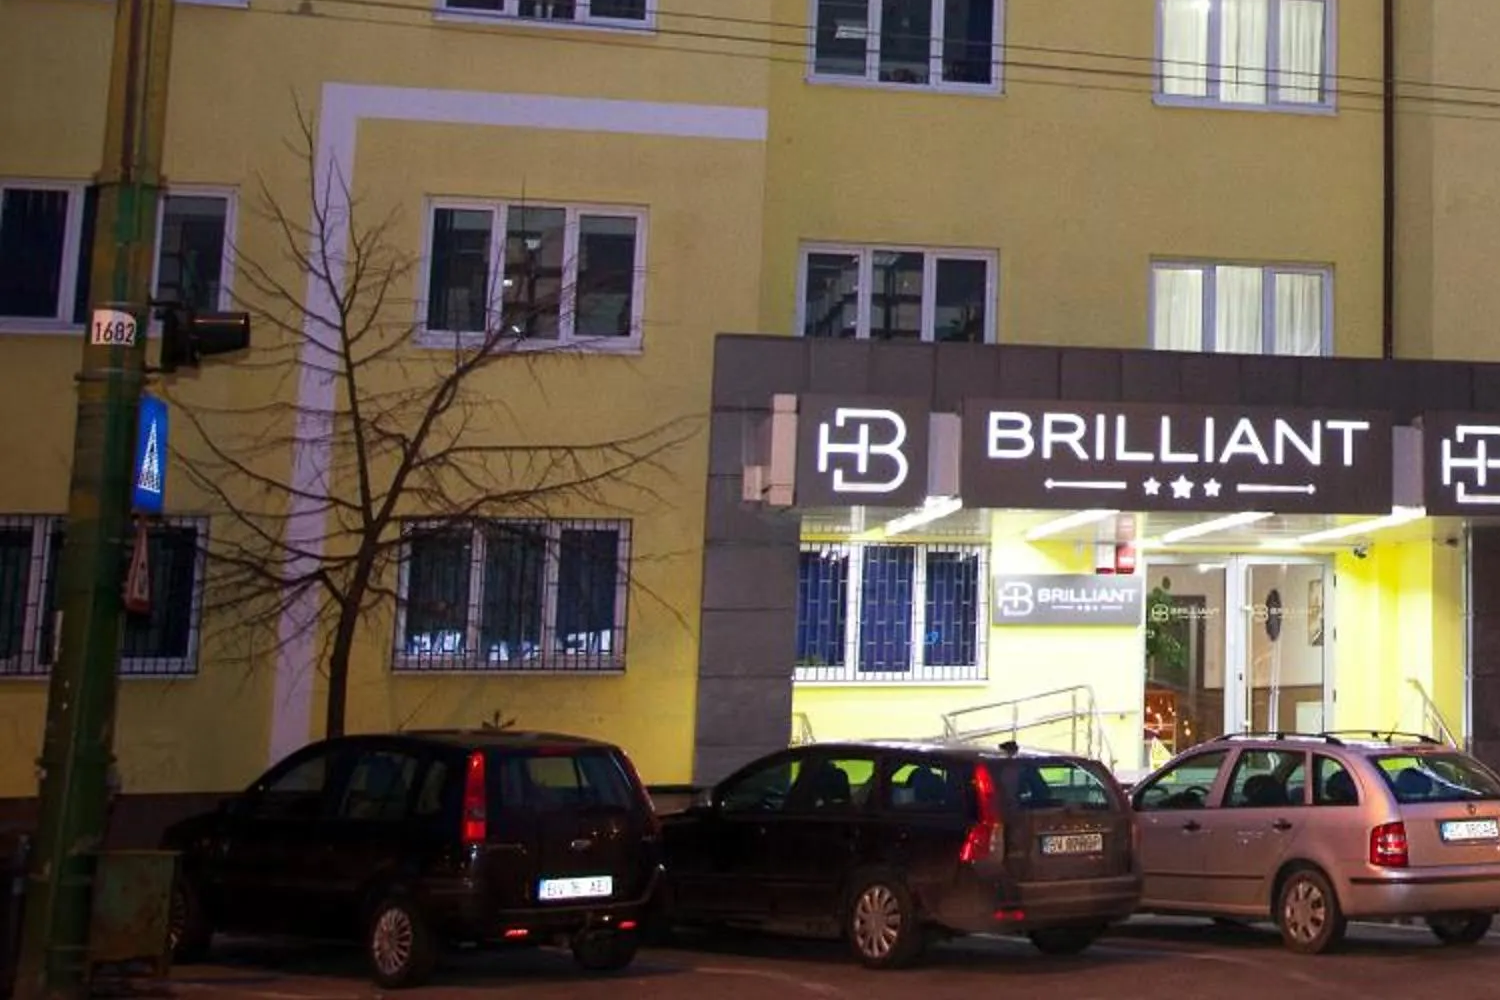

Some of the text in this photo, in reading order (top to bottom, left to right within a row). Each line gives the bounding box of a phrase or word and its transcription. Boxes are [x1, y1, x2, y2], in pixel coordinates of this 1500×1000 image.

[95, 321, 135, 343] 1682
[987, 411, 1370, 467] BRILLIANT
[1037, 587, 1137, 603] BRILLIANT
